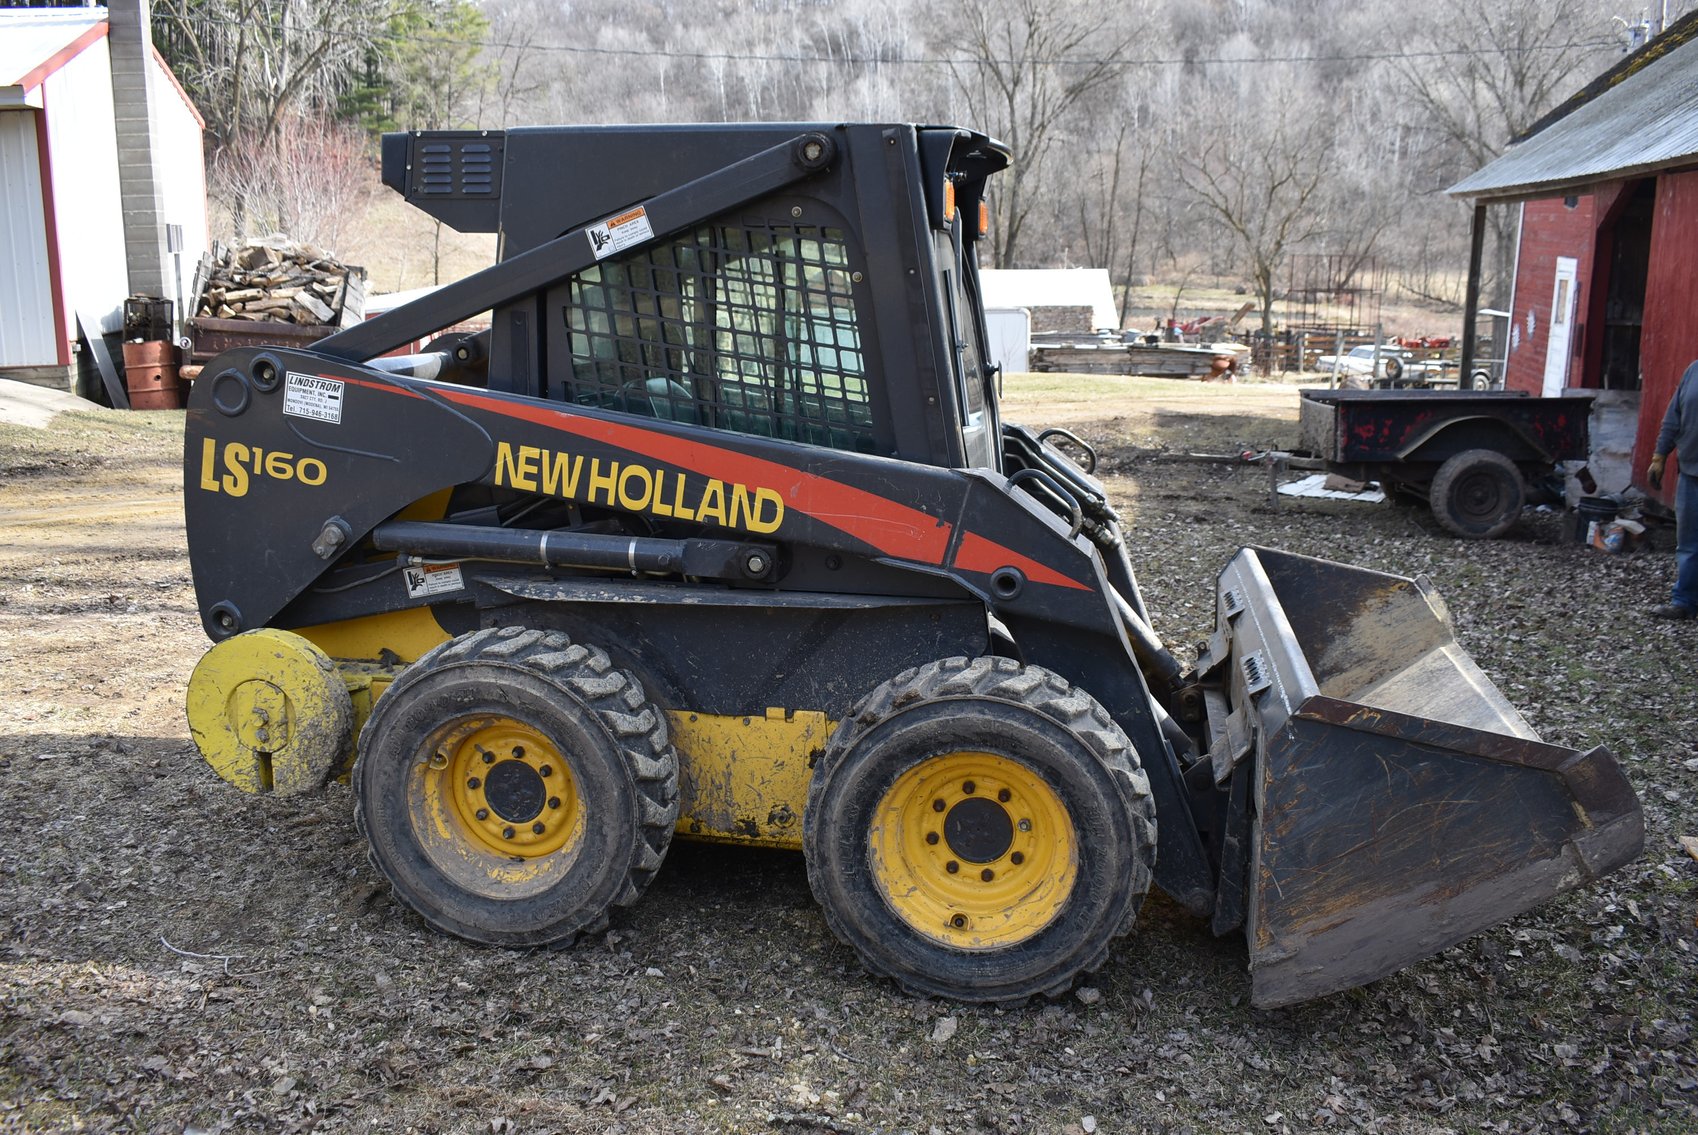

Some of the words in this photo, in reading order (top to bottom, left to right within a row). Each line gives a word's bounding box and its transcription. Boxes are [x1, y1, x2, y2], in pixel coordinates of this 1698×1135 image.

[289, 376, 340, 393] LINDSTROM
[495, 441, 584, 498] NEW
[588, 458, 784, 534] HOLLAND
